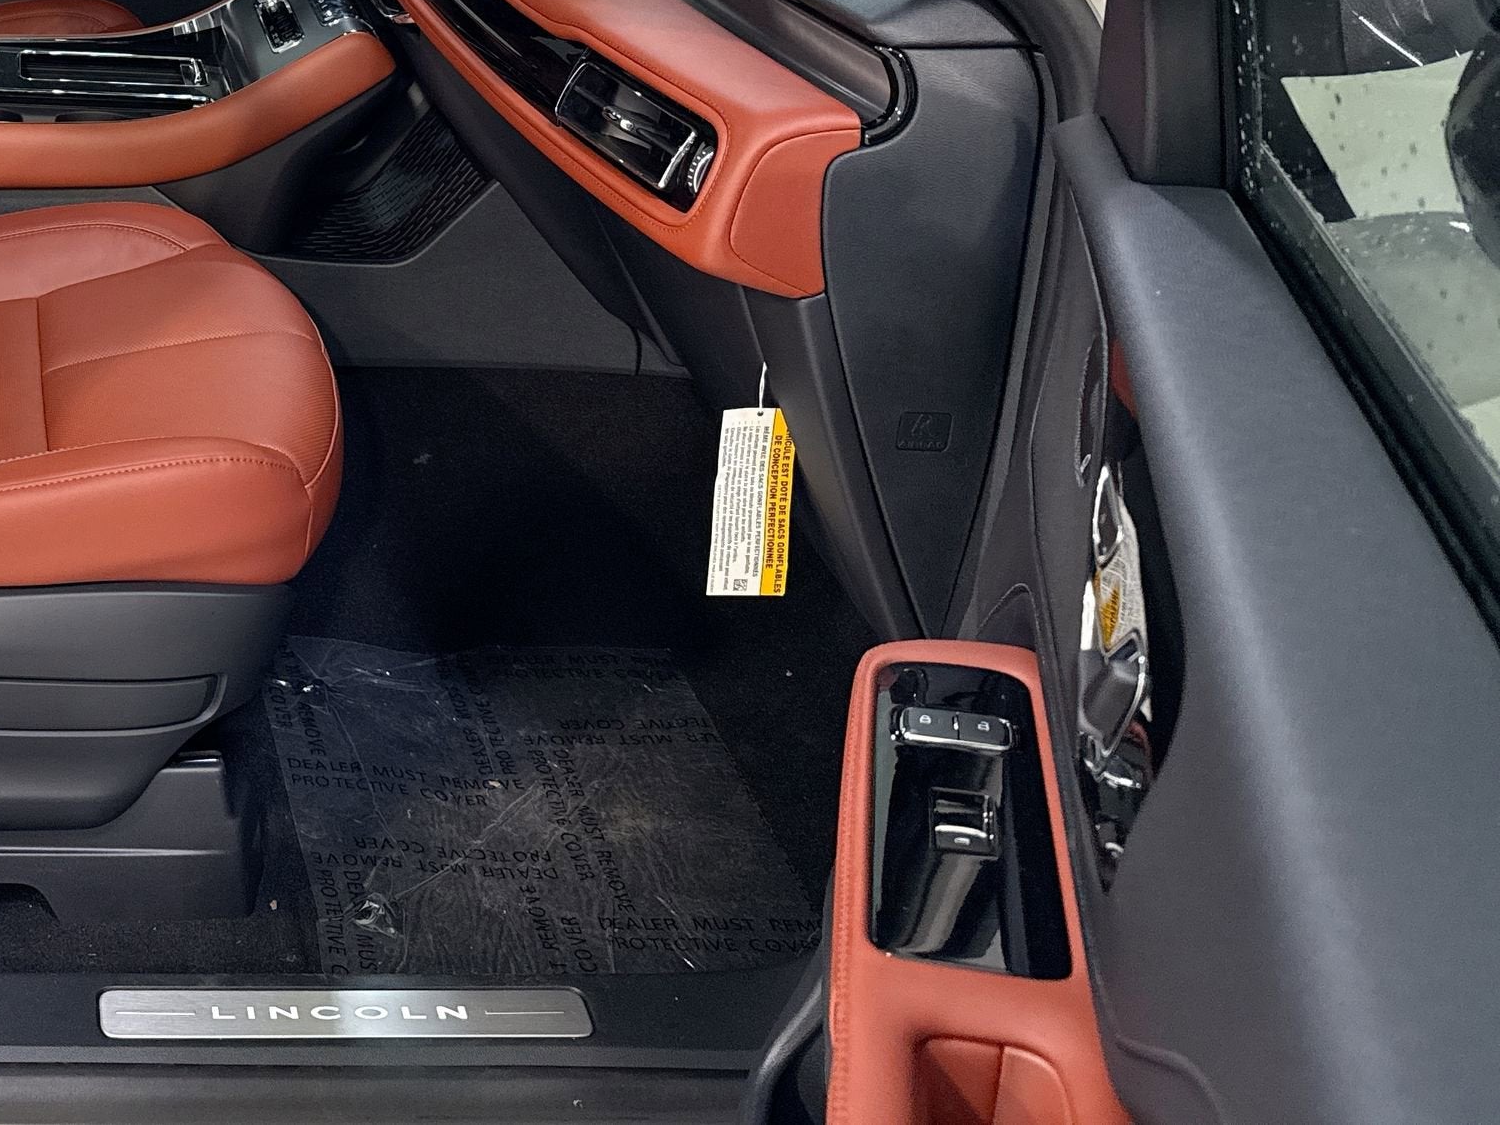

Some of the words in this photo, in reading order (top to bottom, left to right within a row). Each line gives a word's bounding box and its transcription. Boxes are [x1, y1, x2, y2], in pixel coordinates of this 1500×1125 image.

[775, 435, 782, 445] DE
[770, 448, 781, 499] CONCEPTION
[781, 463, 789, 478] EST
[779, 505, 786, 515] DE
[773, 542, 784, 593] GONFLABLES
[557, 719, 625, 731] COVER
[619, 734, 673, 746] MUST
[287, 757, 363, 774] DEALER
[372, 765, 427, 783] MUST
[438, 773, 525, 791] REMOVE
[291, 773, 409, 796] PROTECTIVE
[419, 787, 488, 807] COVER
[353, 836, 426, 855] COVER
[560, 832, 596, 882] COVER
[578, 805, 606, 842] MUST
[594, 849, 638, 914] REMOVE
[481, 866, 559, 881] DEALER
[519, 884, 562, 953] REMOVE
[597, 916, 680, 932] DEALER
[690, 917, 756, 932] MUST
[560, 916, 598, 974] COVER
[210, 1005, 469, 1021] LINCOLN
